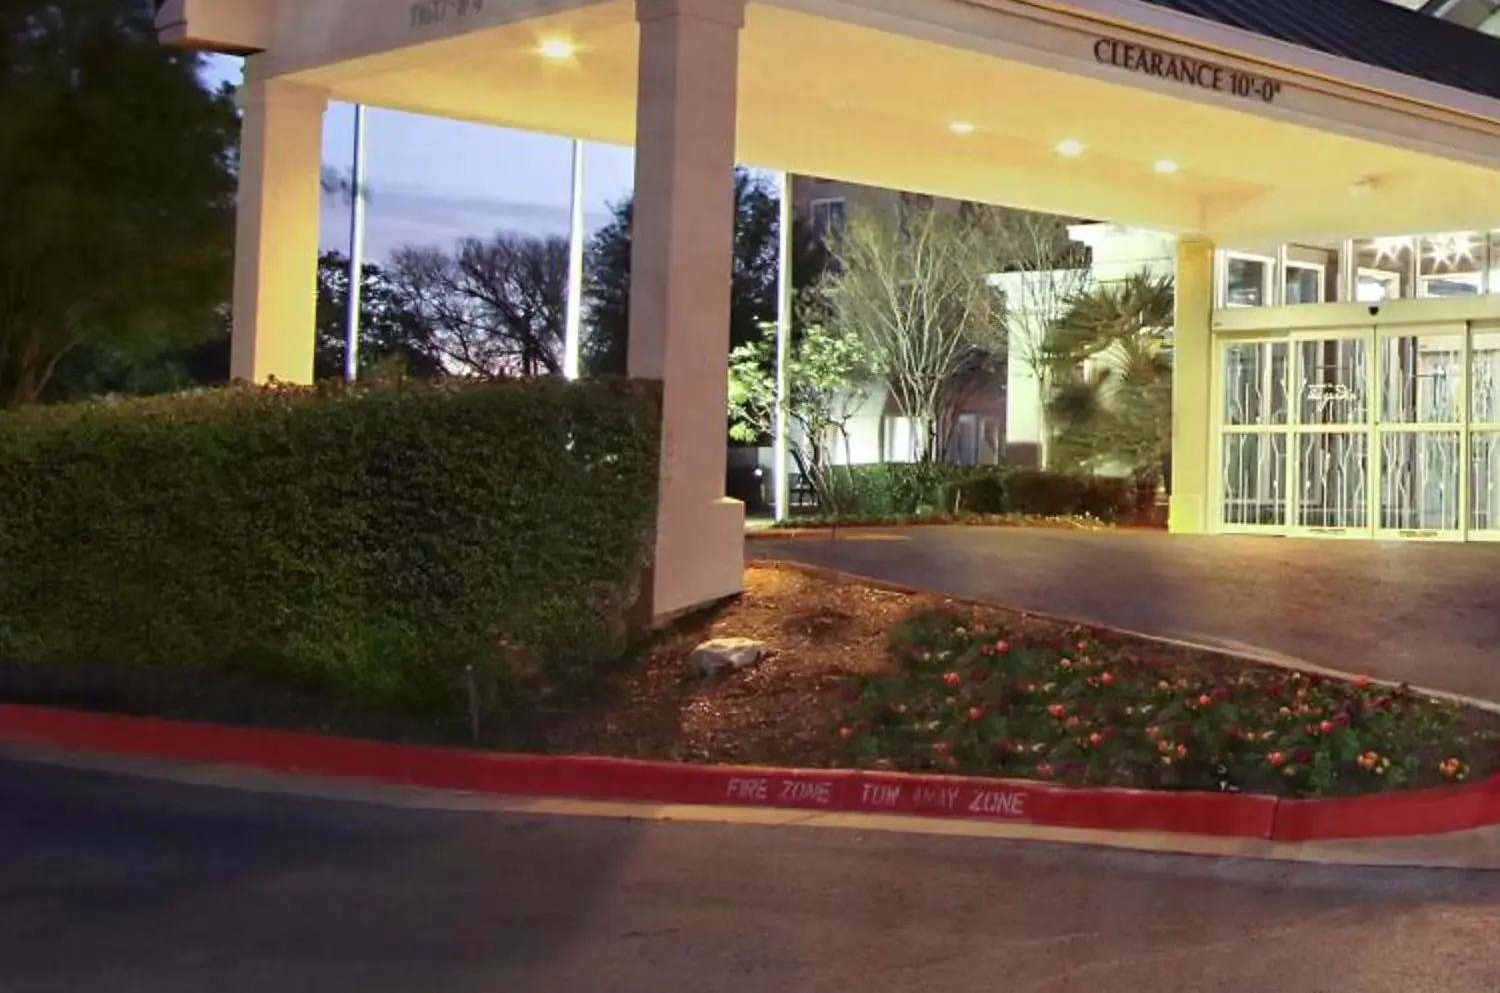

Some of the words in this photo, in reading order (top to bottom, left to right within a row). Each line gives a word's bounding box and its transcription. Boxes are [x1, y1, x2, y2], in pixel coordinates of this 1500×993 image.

[1093, 38, 1225, 91] CLEARANCE
[726, 778, 767, 800] FIRE
[780, 780, 832, 803] ZONE
[861, 783, 901, 806] TOW
[968, 789, 1029, 815] ZONE
